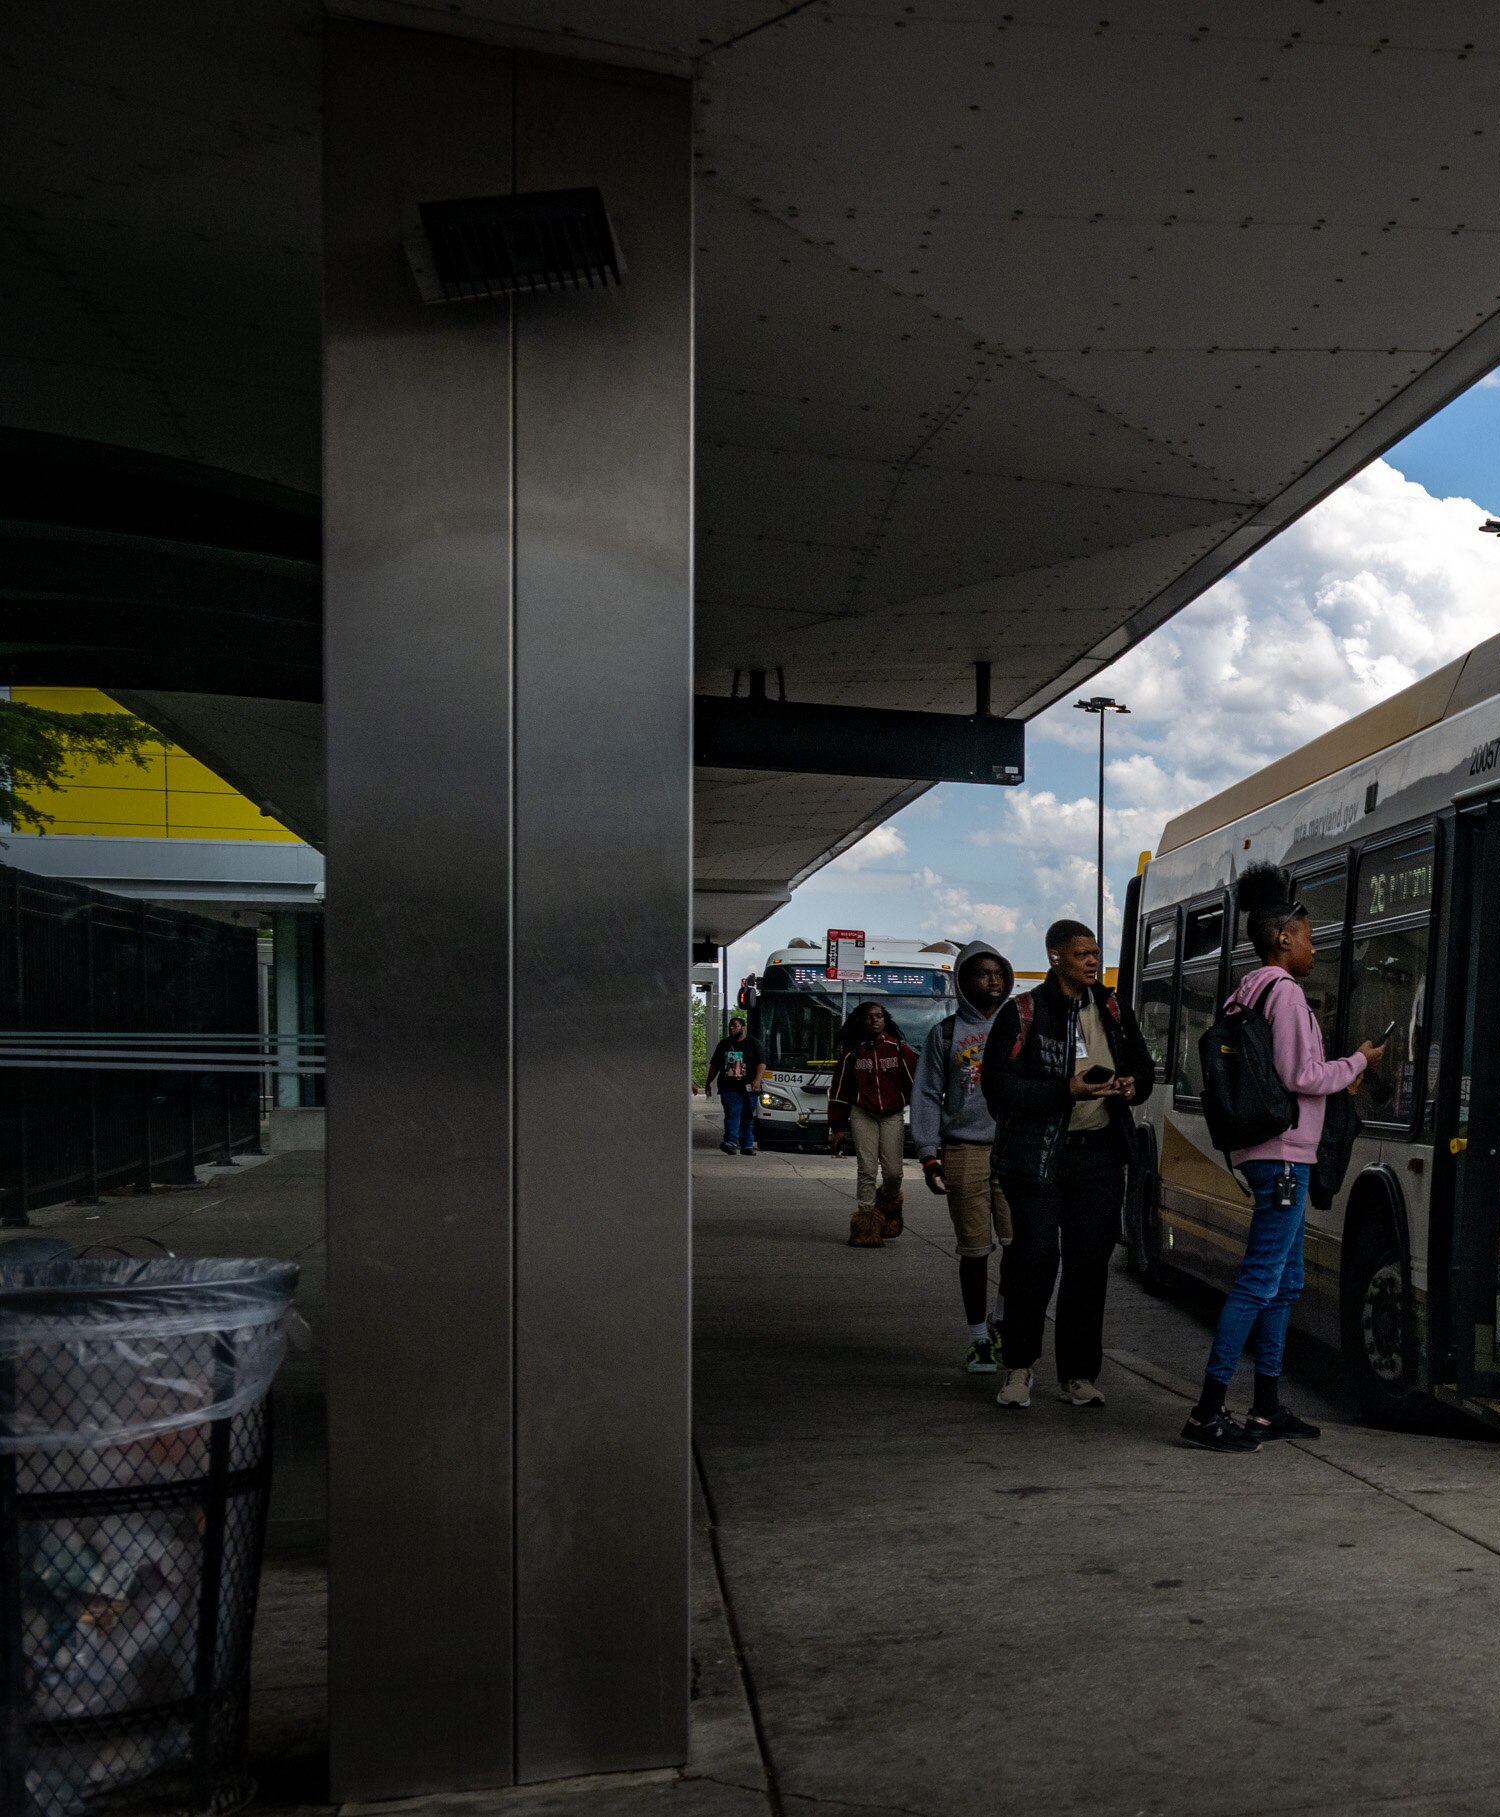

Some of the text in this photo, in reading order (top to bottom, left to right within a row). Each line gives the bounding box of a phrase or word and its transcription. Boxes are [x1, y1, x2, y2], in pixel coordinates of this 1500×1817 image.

[1469, 739, 1500, 777] 20057
[1293, 801, 1360, 844] mta.maryland.gov
[855, 1057, 899, 1069] BOSTON
[773, 1073, 803, 1084] 18044
